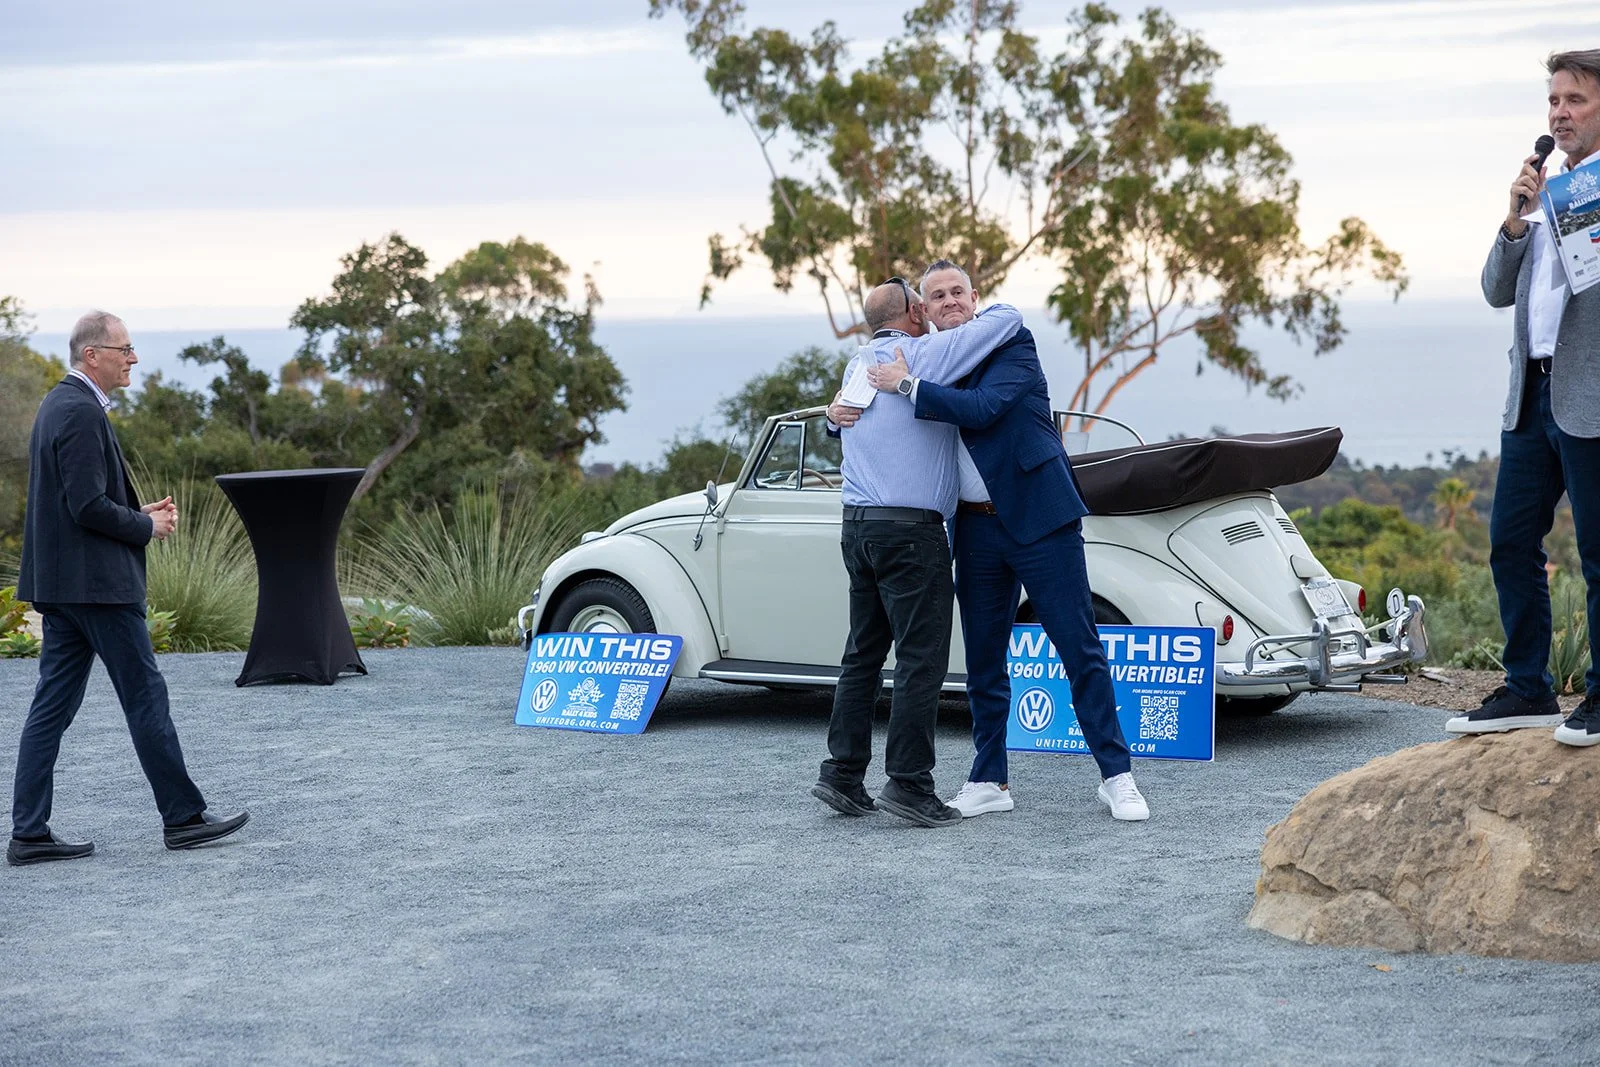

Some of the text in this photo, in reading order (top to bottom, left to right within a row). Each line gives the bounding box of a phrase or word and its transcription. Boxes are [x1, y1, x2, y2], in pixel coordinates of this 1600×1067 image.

[536, 637, 673, 660] WIN THIS
[1008, 631, 1202, 662] WI THIS
[529, 660, 670, 677] 1960 VW CONVERTIBLE!
[1006, 661, 1044, 679] 1960
[535, 716, 620, 730] UNITEDBG.ORG.COM
